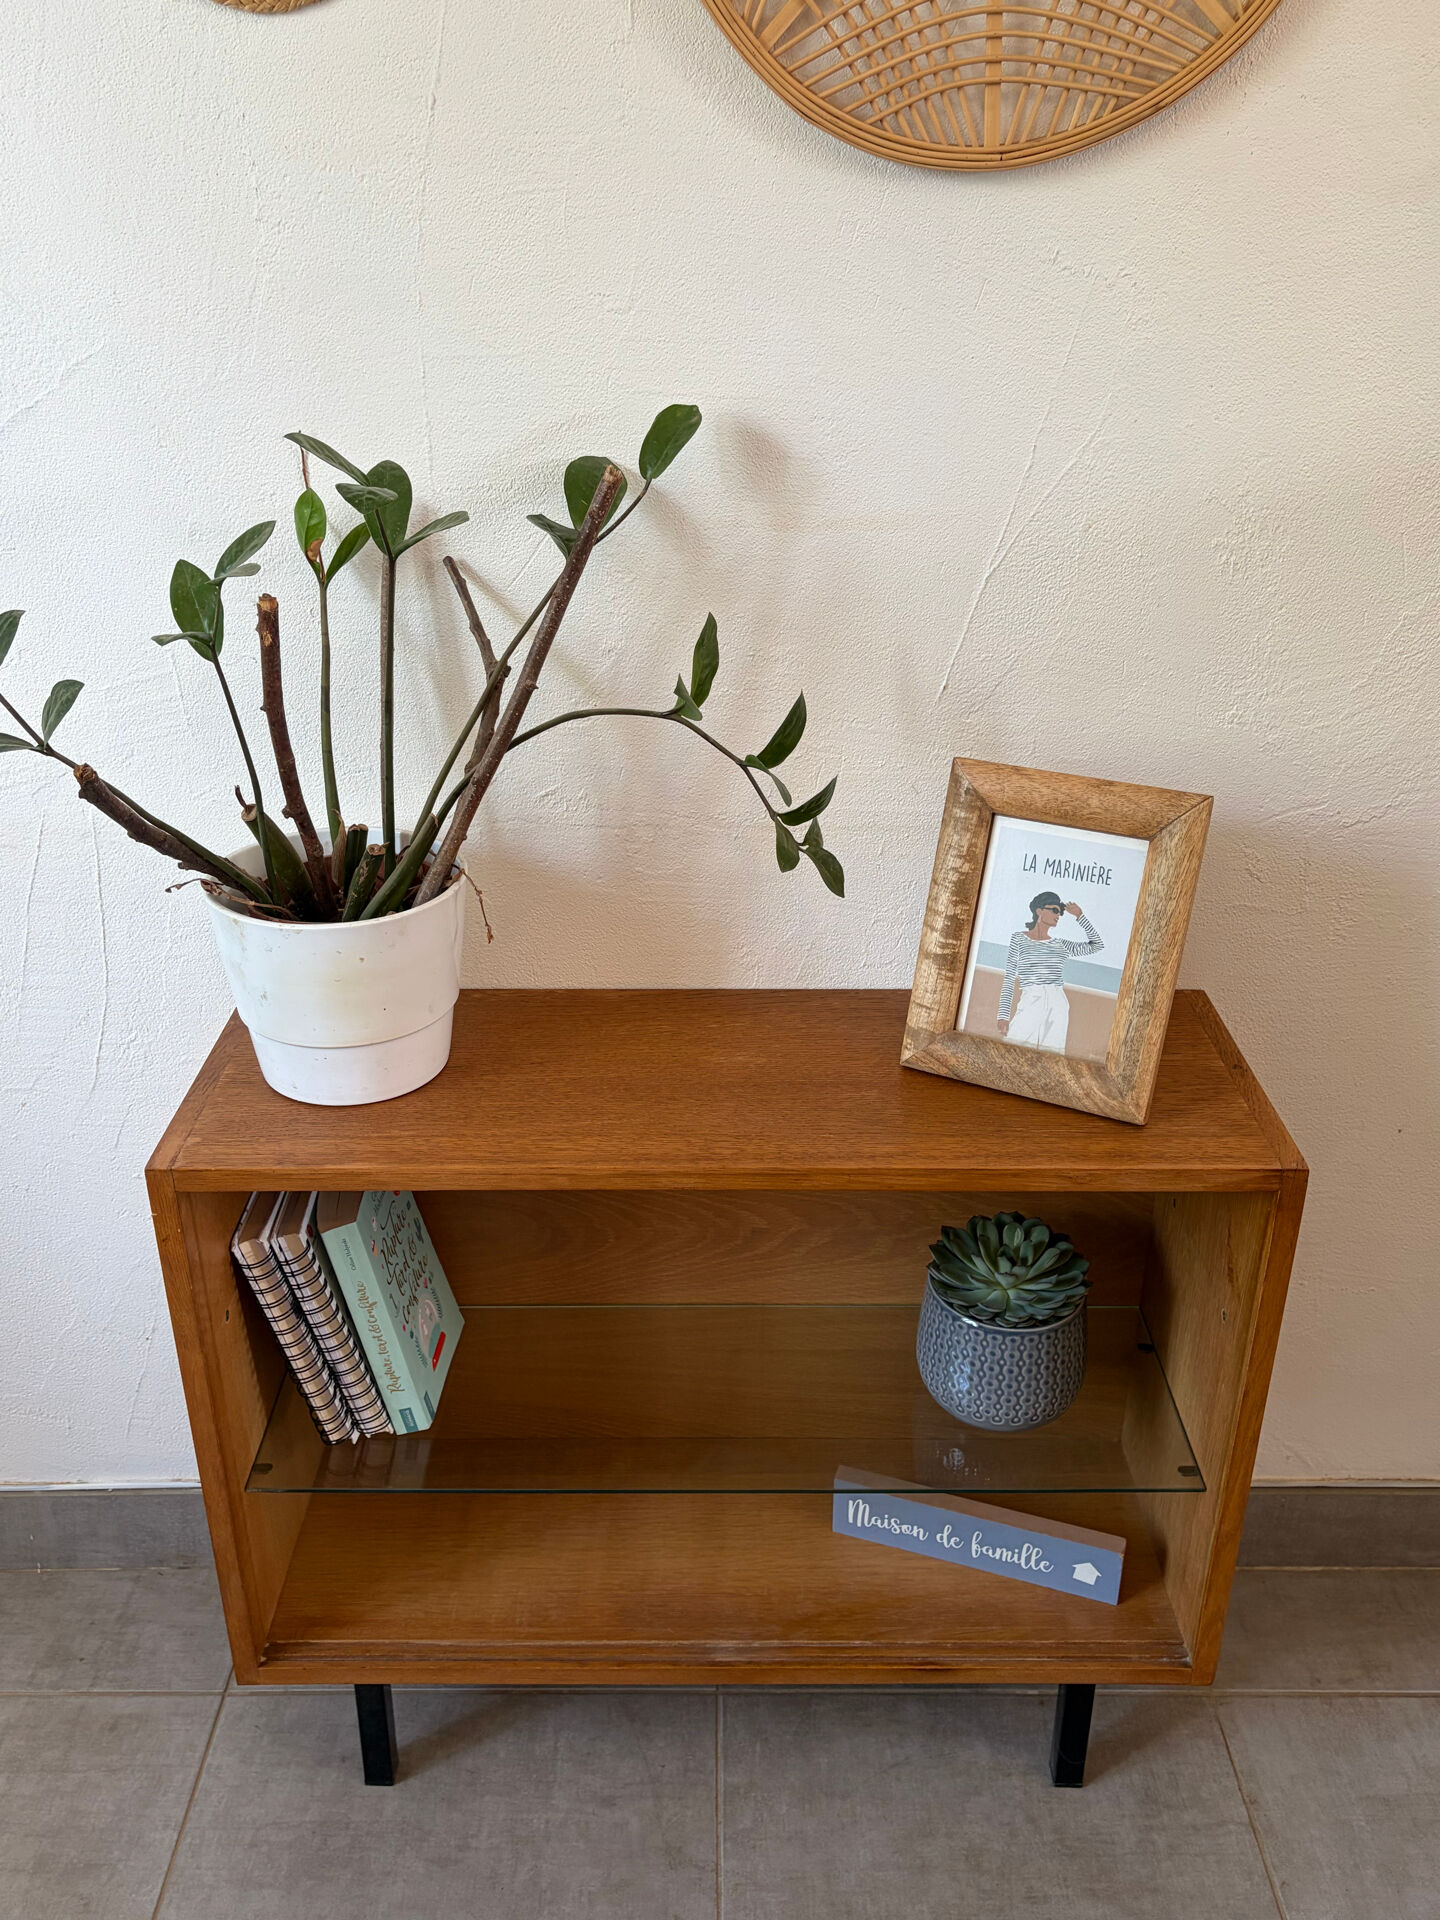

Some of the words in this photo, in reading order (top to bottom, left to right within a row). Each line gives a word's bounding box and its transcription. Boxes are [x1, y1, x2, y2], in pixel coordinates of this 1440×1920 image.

[1022, 853, 1037, 873] LA
[1044, 858, 1113, 886] MARINIÈRE
[848, 1499, 929, 1542] Maison
[935, 1524, 964, 1549] de
[971, 1531, 1054, 1574] famille
